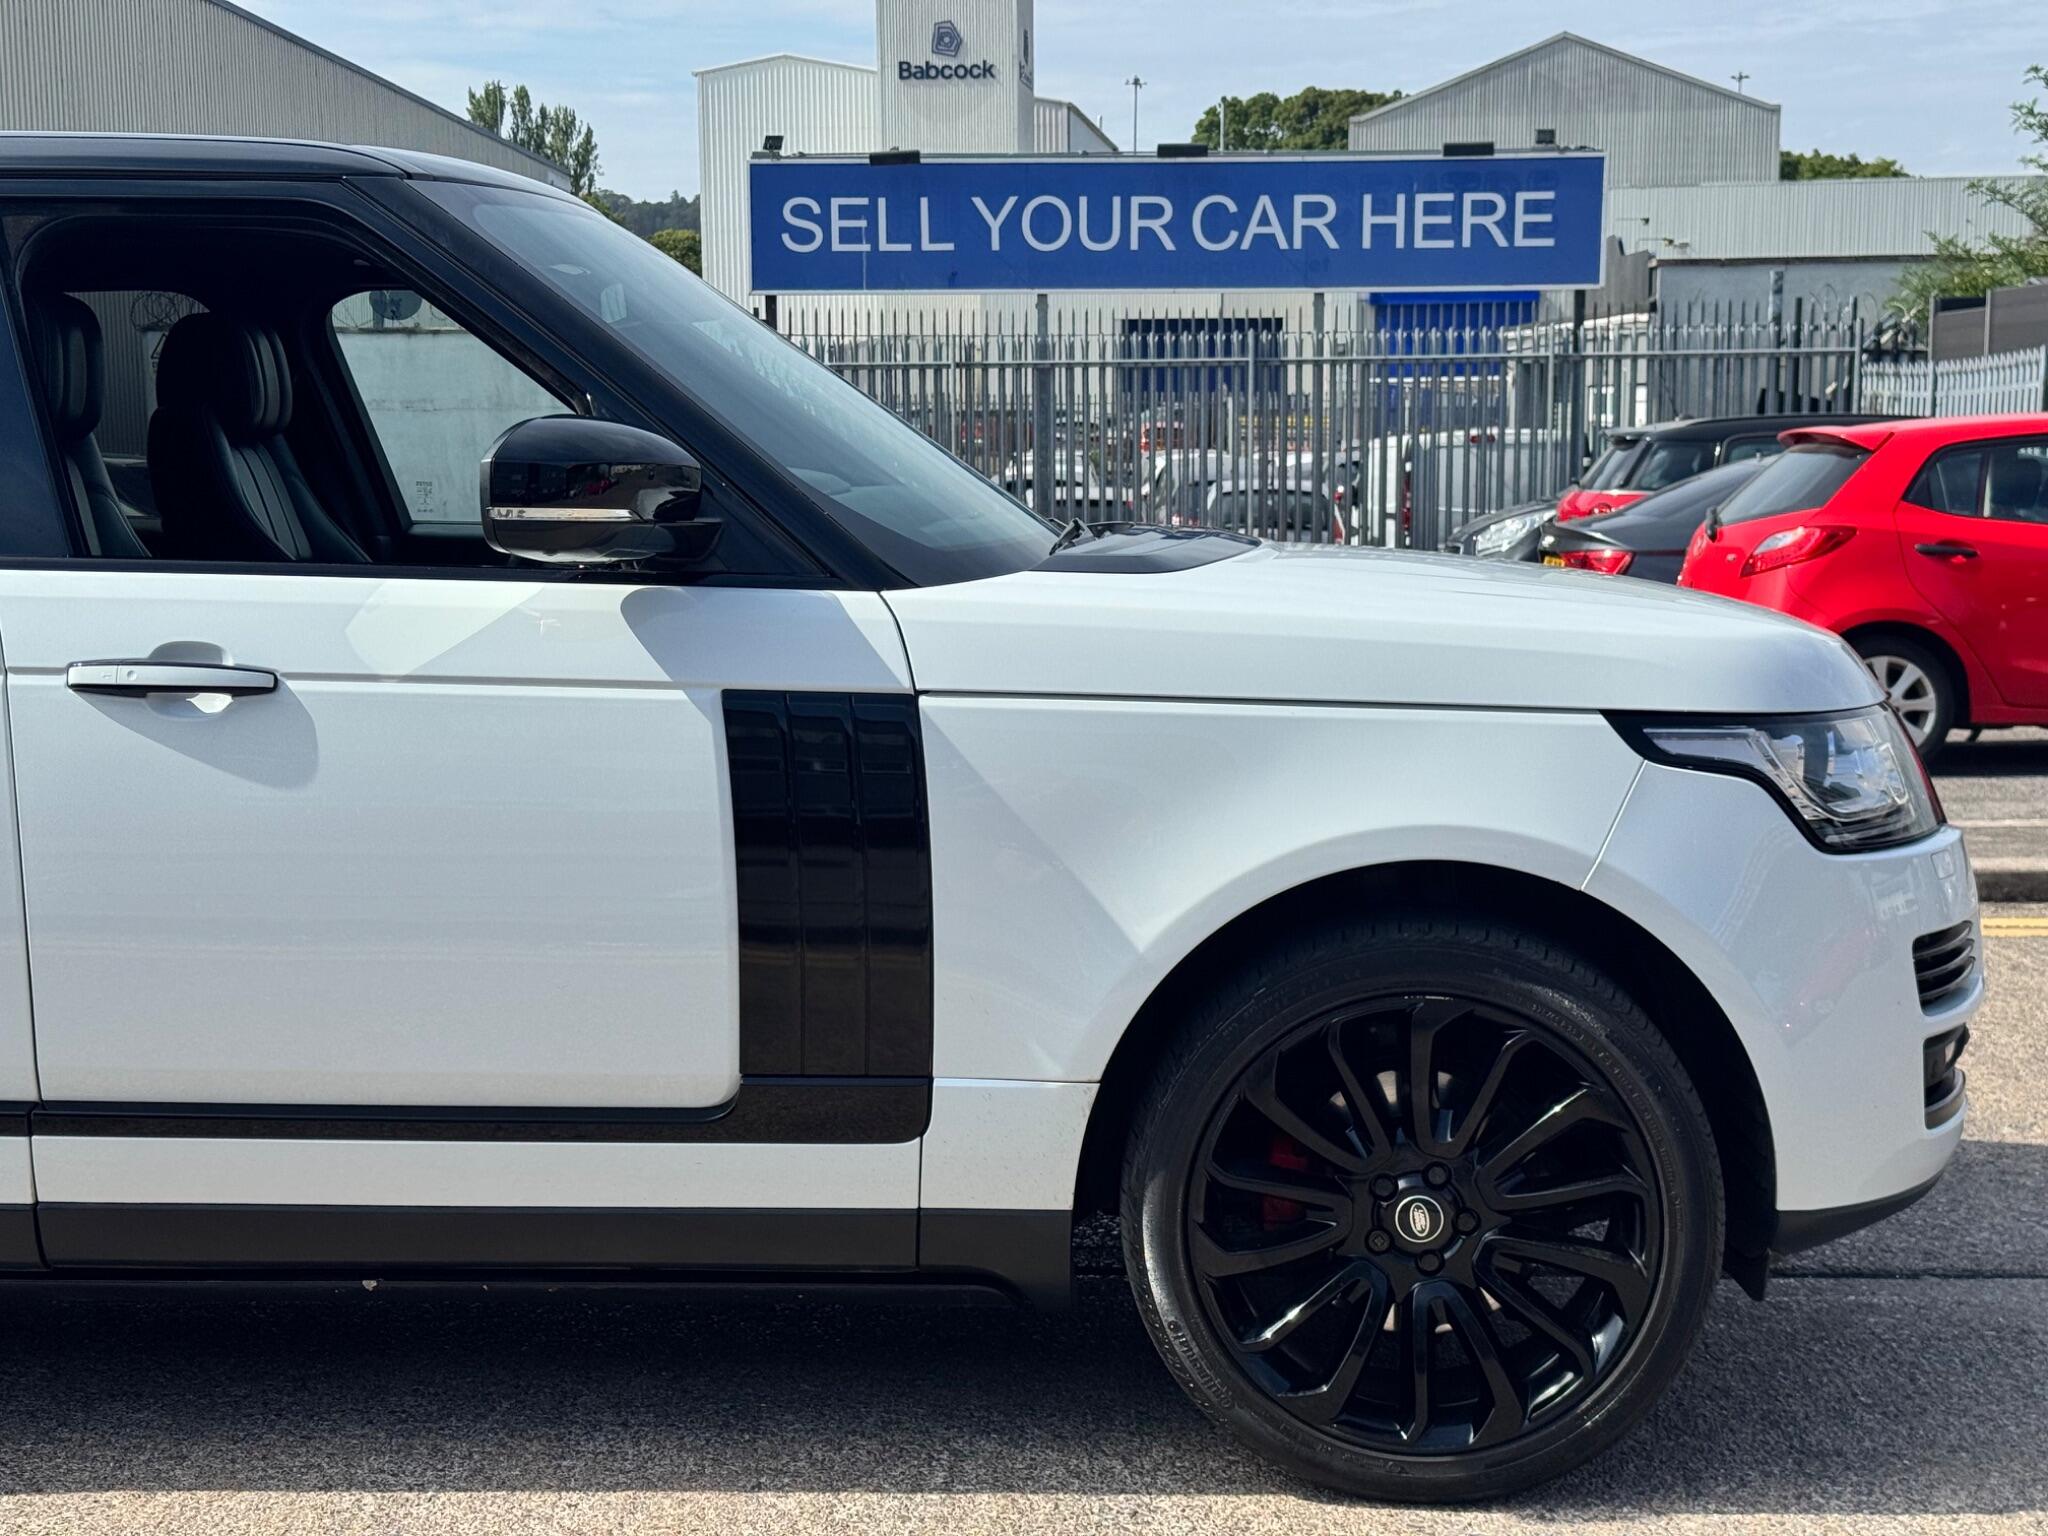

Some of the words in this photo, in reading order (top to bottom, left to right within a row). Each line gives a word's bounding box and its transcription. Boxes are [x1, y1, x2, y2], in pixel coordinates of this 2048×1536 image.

[898, 60, 995, 80] Babcock
[781, 197, 955, 253] SELL
[970, 195, 1177, 252] YOUR
[1192, 194, 1341, 251] CAR
[1361, 191, 1556, 250] HERE
